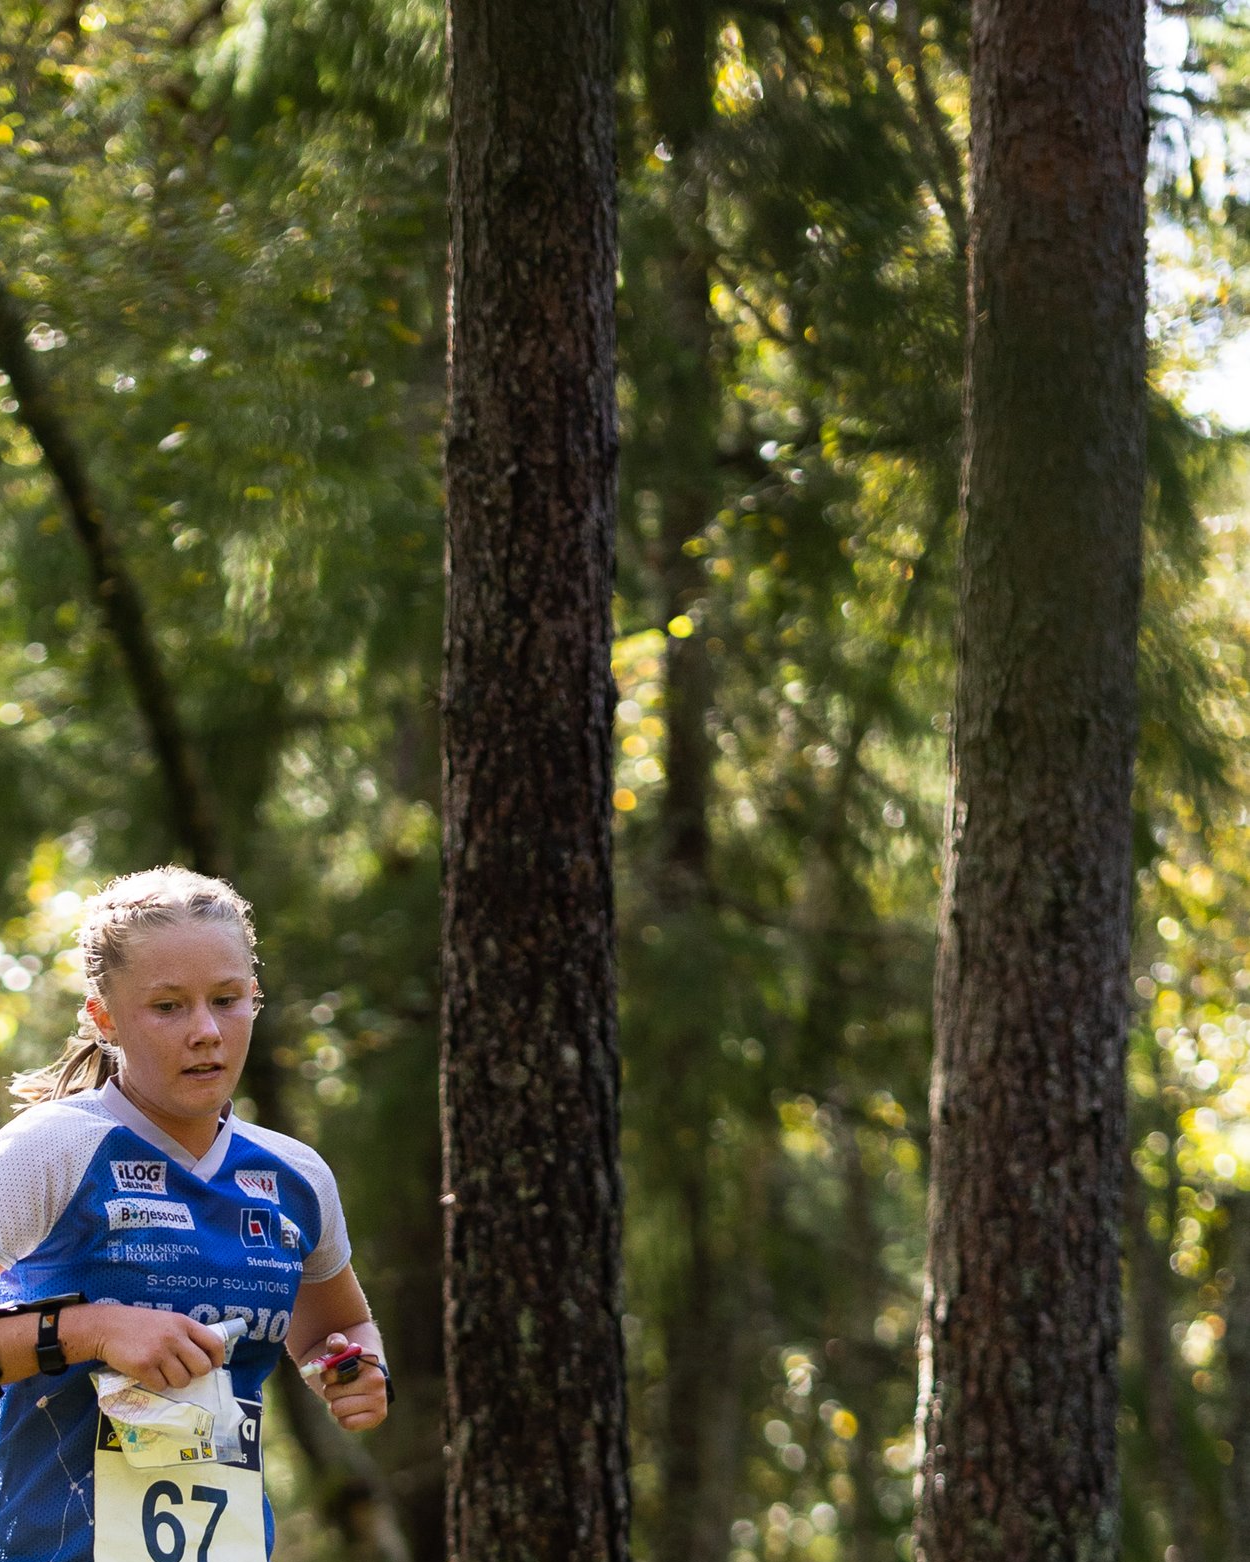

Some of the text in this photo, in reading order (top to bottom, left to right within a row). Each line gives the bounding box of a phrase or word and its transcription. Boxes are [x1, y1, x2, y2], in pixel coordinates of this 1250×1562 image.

[118, 1164, 161, 1182] iLOG
[121, 1181, 153, 1190] DELIVER
[125, 1244, 200, 1255] KARLSKRONA
[125, 1252, 179, 1262] KOMMUN
[147, 1274, 289, 1294] S-GROUP SOLUTIONS
